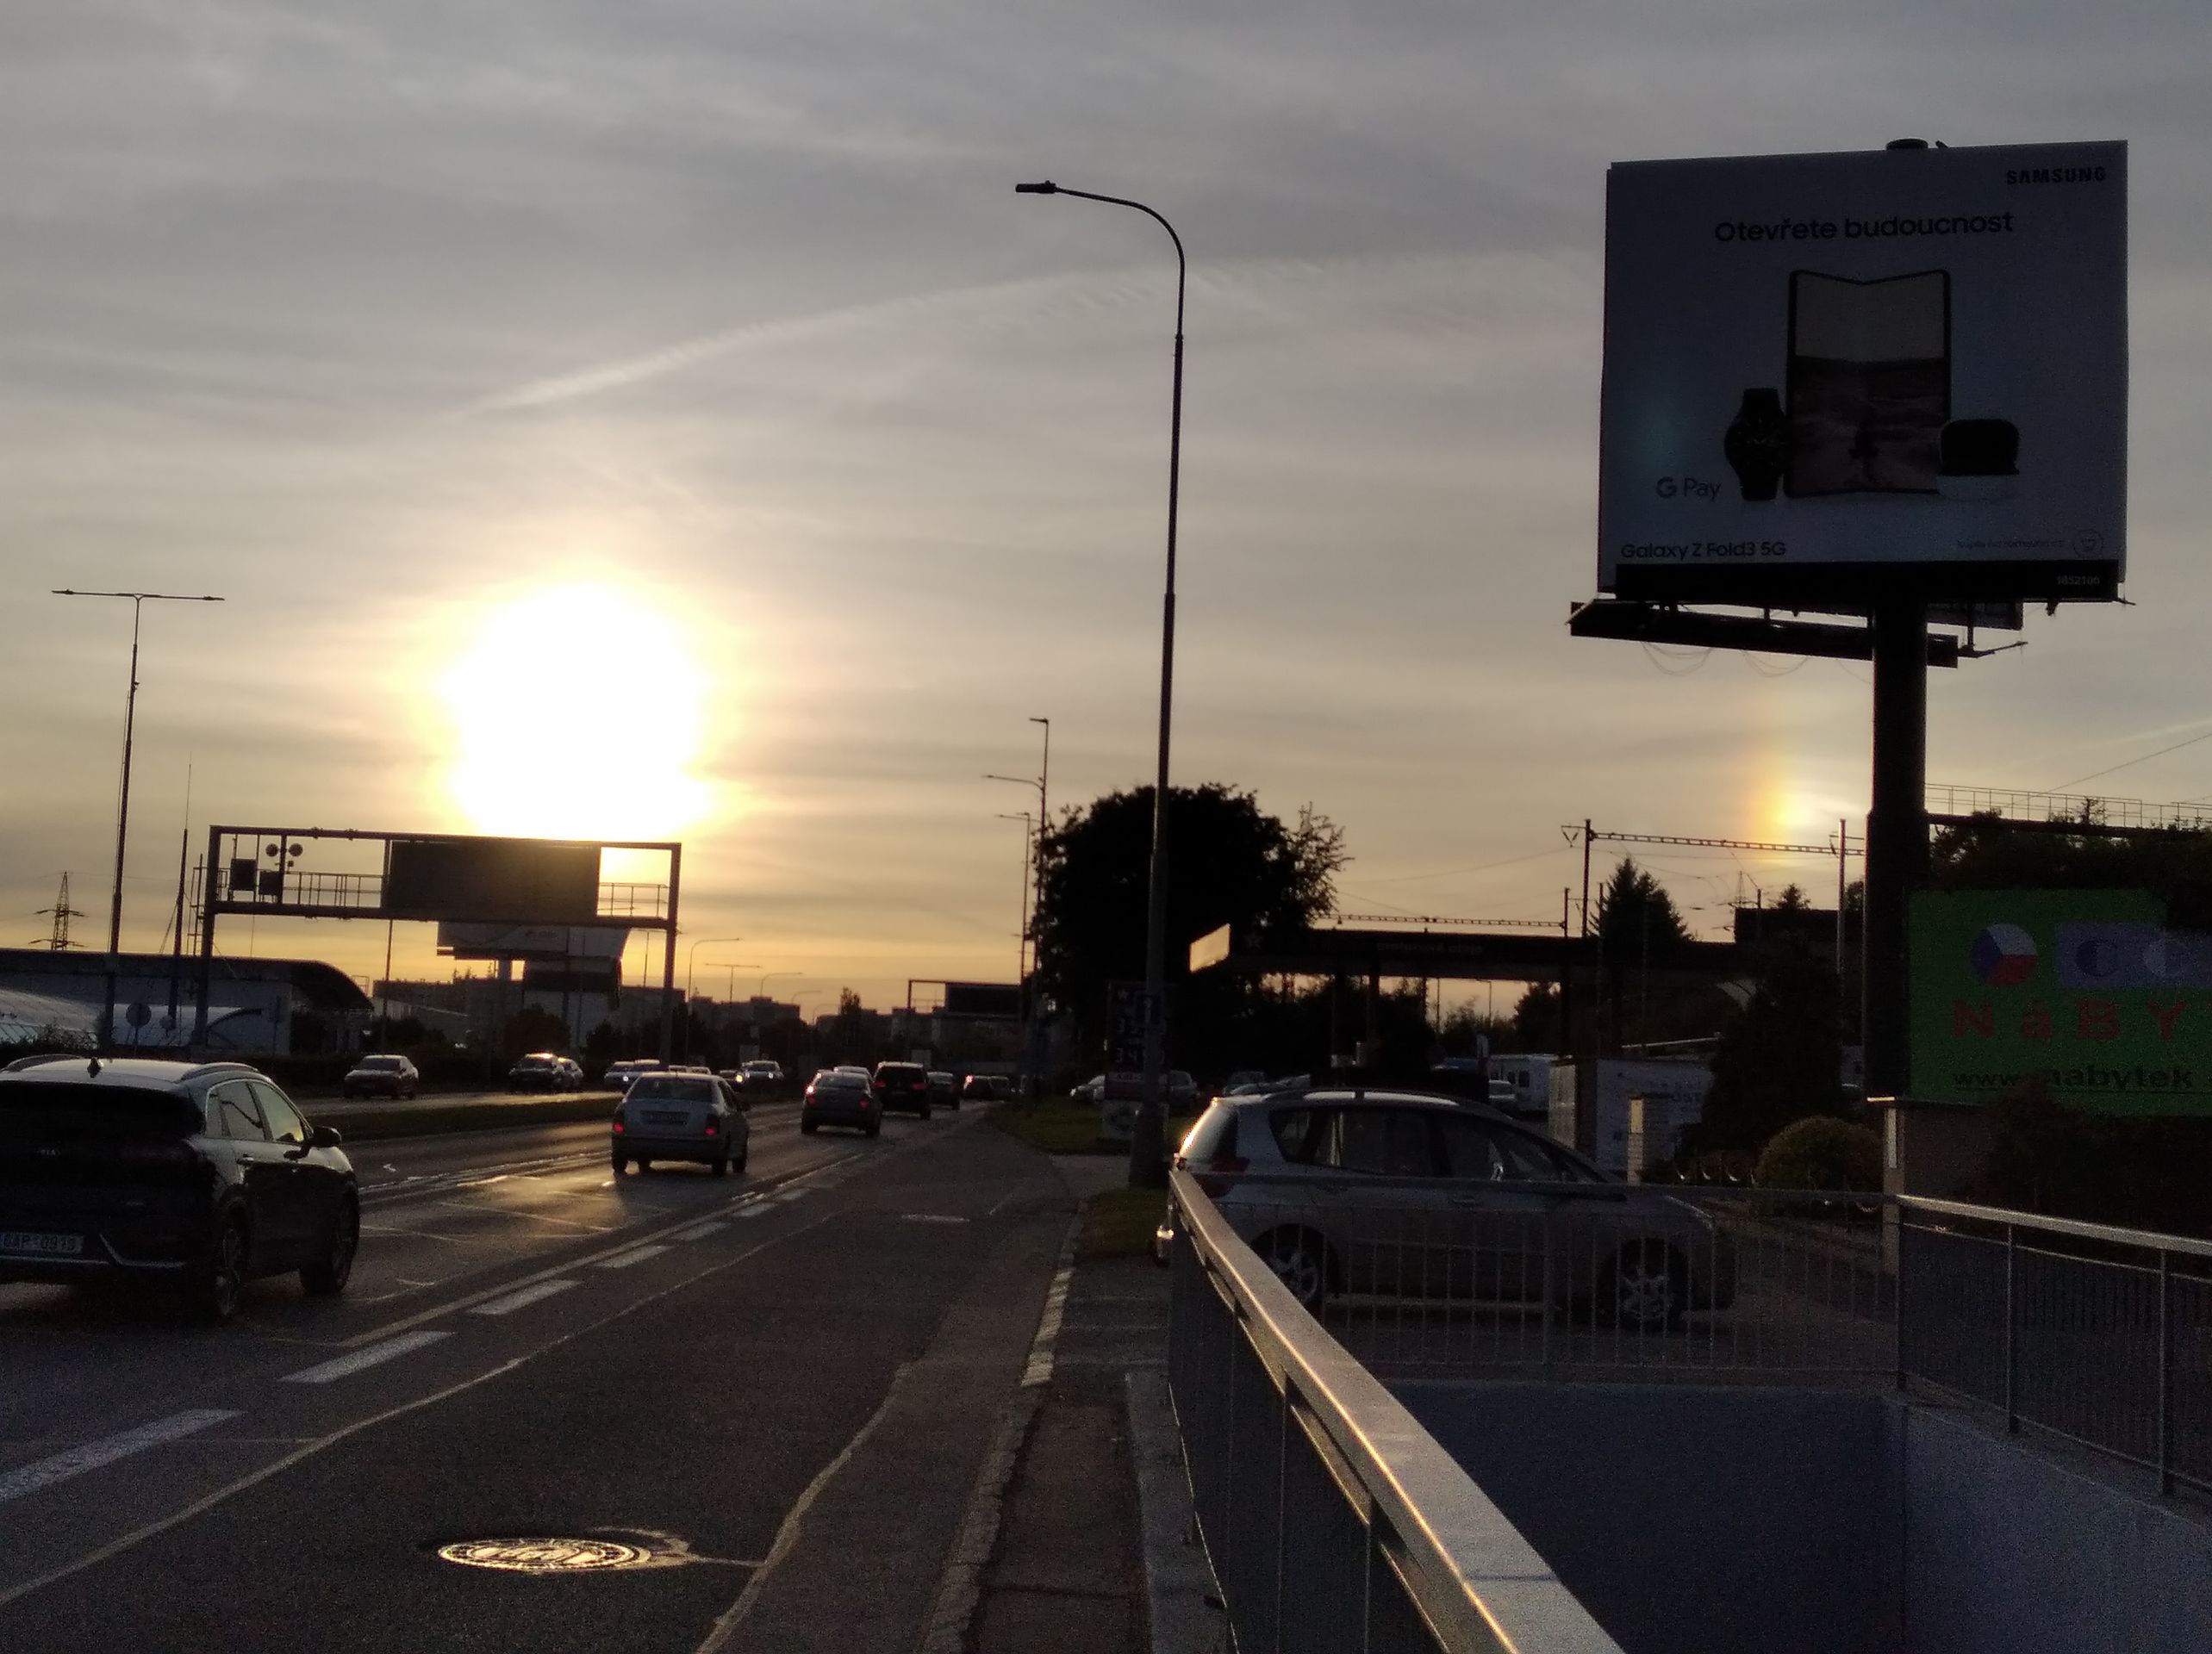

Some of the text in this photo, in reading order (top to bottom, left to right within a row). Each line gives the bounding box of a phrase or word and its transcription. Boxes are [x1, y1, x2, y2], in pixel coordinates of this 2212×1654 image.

[2005, 166, 2106, 185] SAMSUNG
[1715, 211, 2014, 242] Otevřete budoucnost
[1655, 476, 1722, 501] G Pay
[1621, 541, 1786, 560] Galaxy Z Fold3 5G
